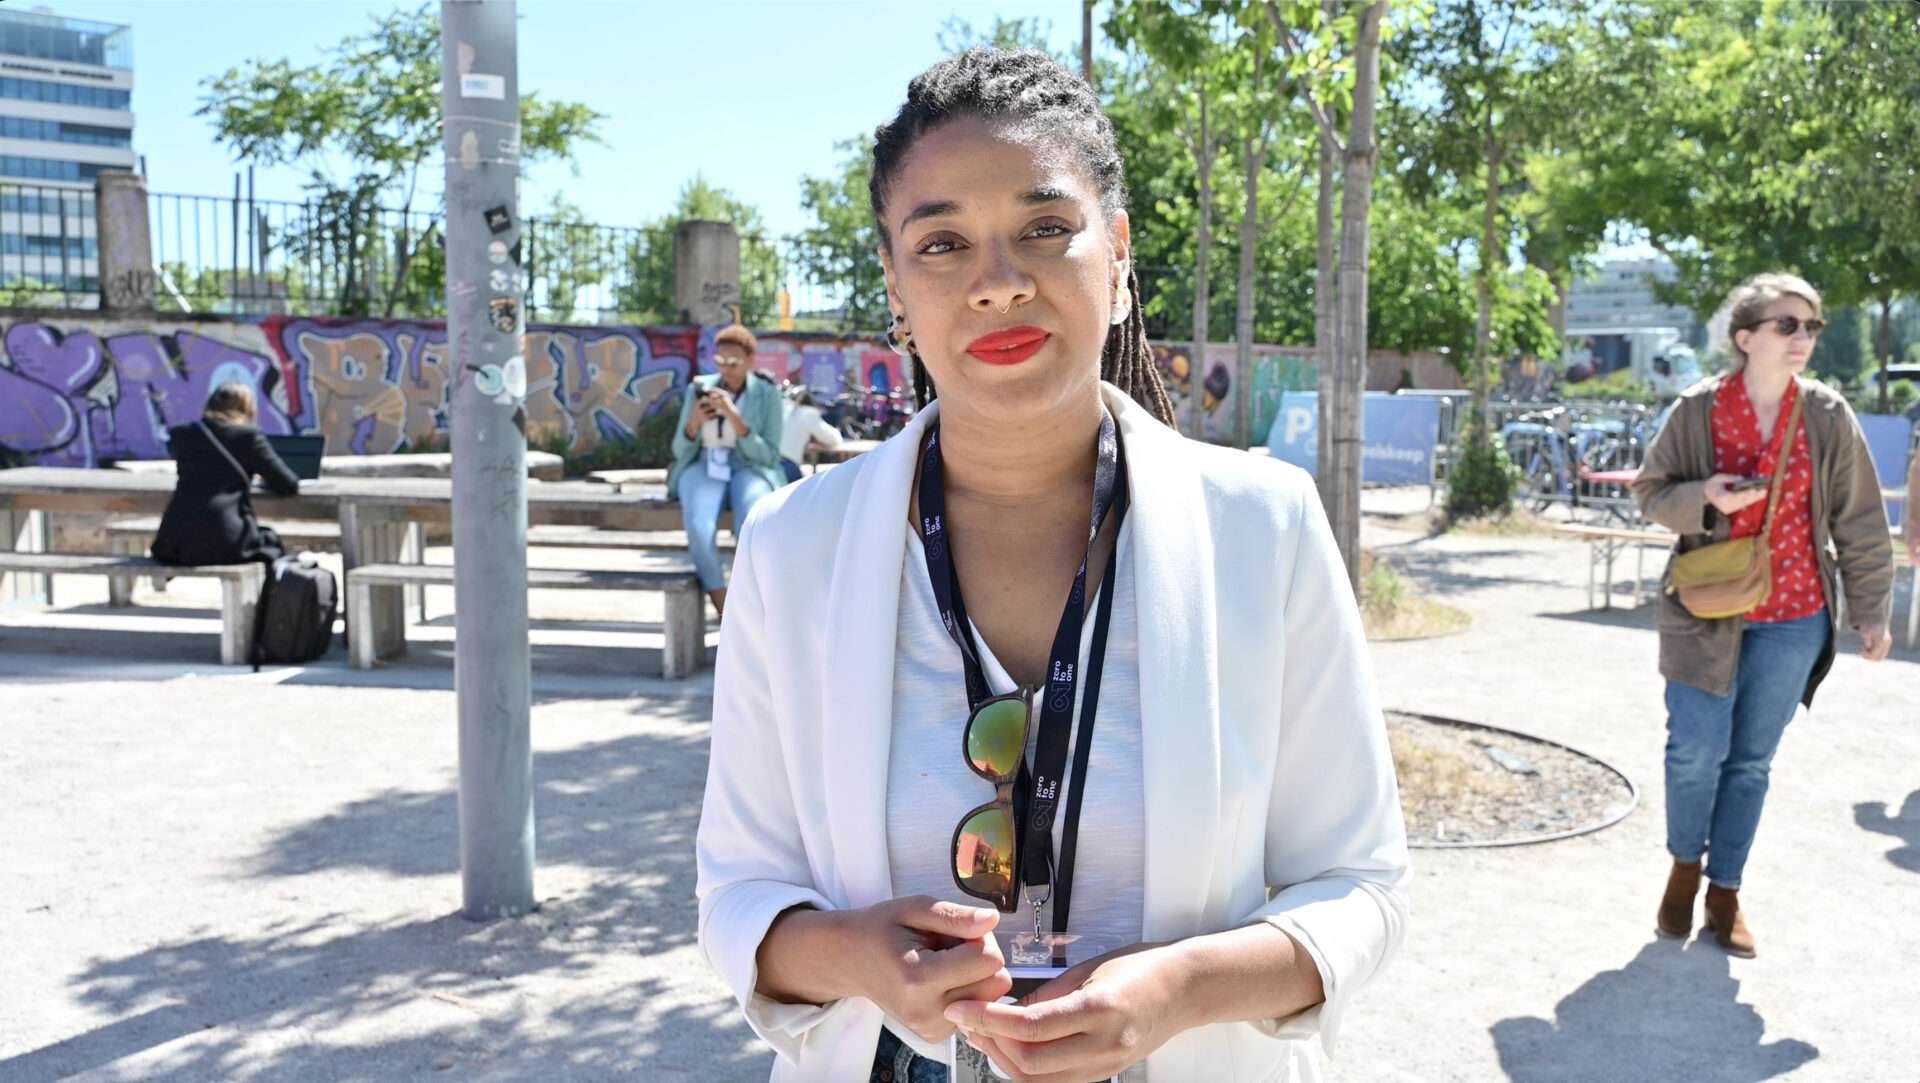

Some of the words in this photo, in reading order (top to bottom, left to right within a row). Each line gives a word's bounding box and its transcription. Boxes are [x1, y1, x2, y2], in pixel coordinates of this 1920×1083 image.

[930, 524, 936, 534] to
[1052, 660, 1061, 682] zero
[1058, 671, 1067, 682] to
[1066, 663, 1074, 682] one
[1035, 775, 1045, 798] zero
[1041, 788, 1049, 798] to
[1048, 780, 1057, 799] one
